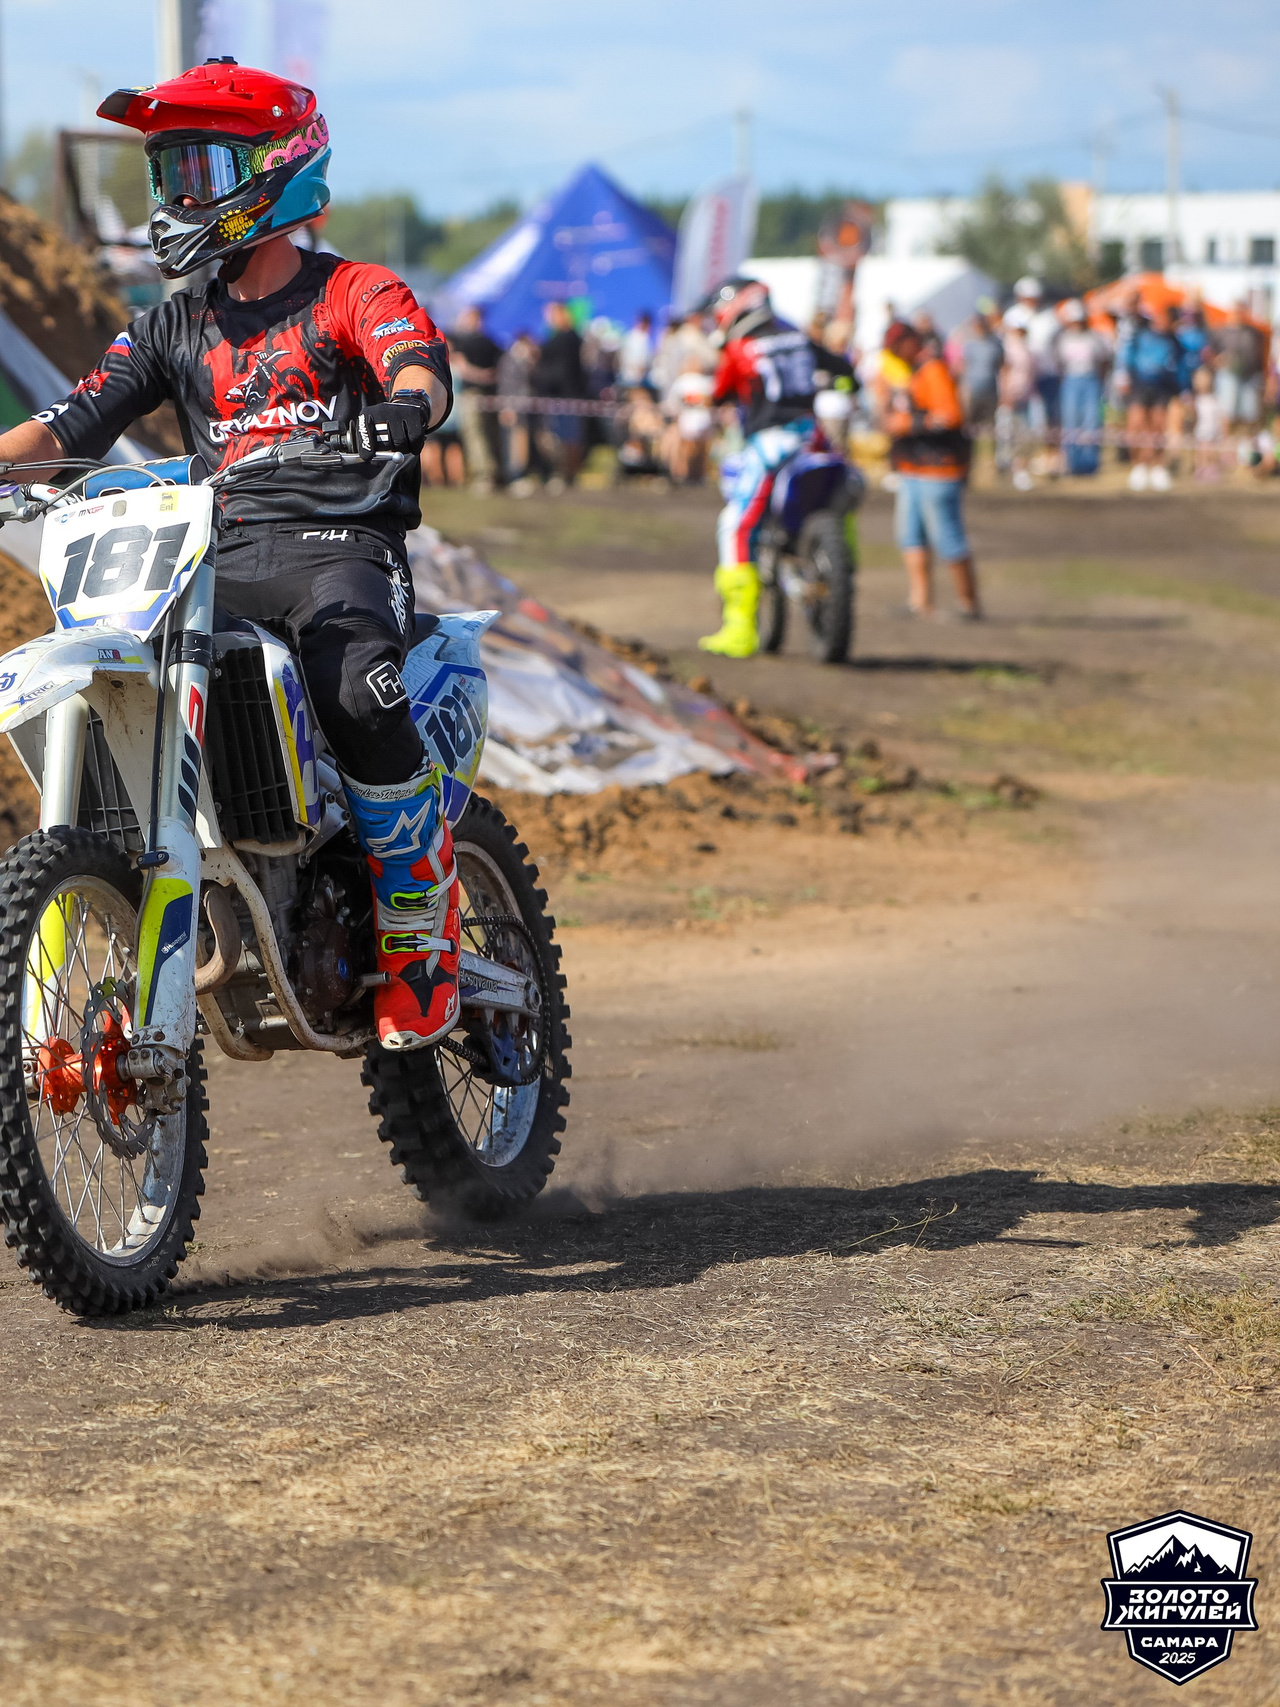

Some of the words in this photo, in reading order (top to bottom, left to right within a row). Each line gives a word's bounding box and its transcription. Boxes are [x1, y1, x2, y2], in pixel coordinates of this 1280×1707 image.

[209, 395, 337, 443] GRYAZNOV
[57, 522, 191, 608] 181
[423, 683, 483, 775] 181
